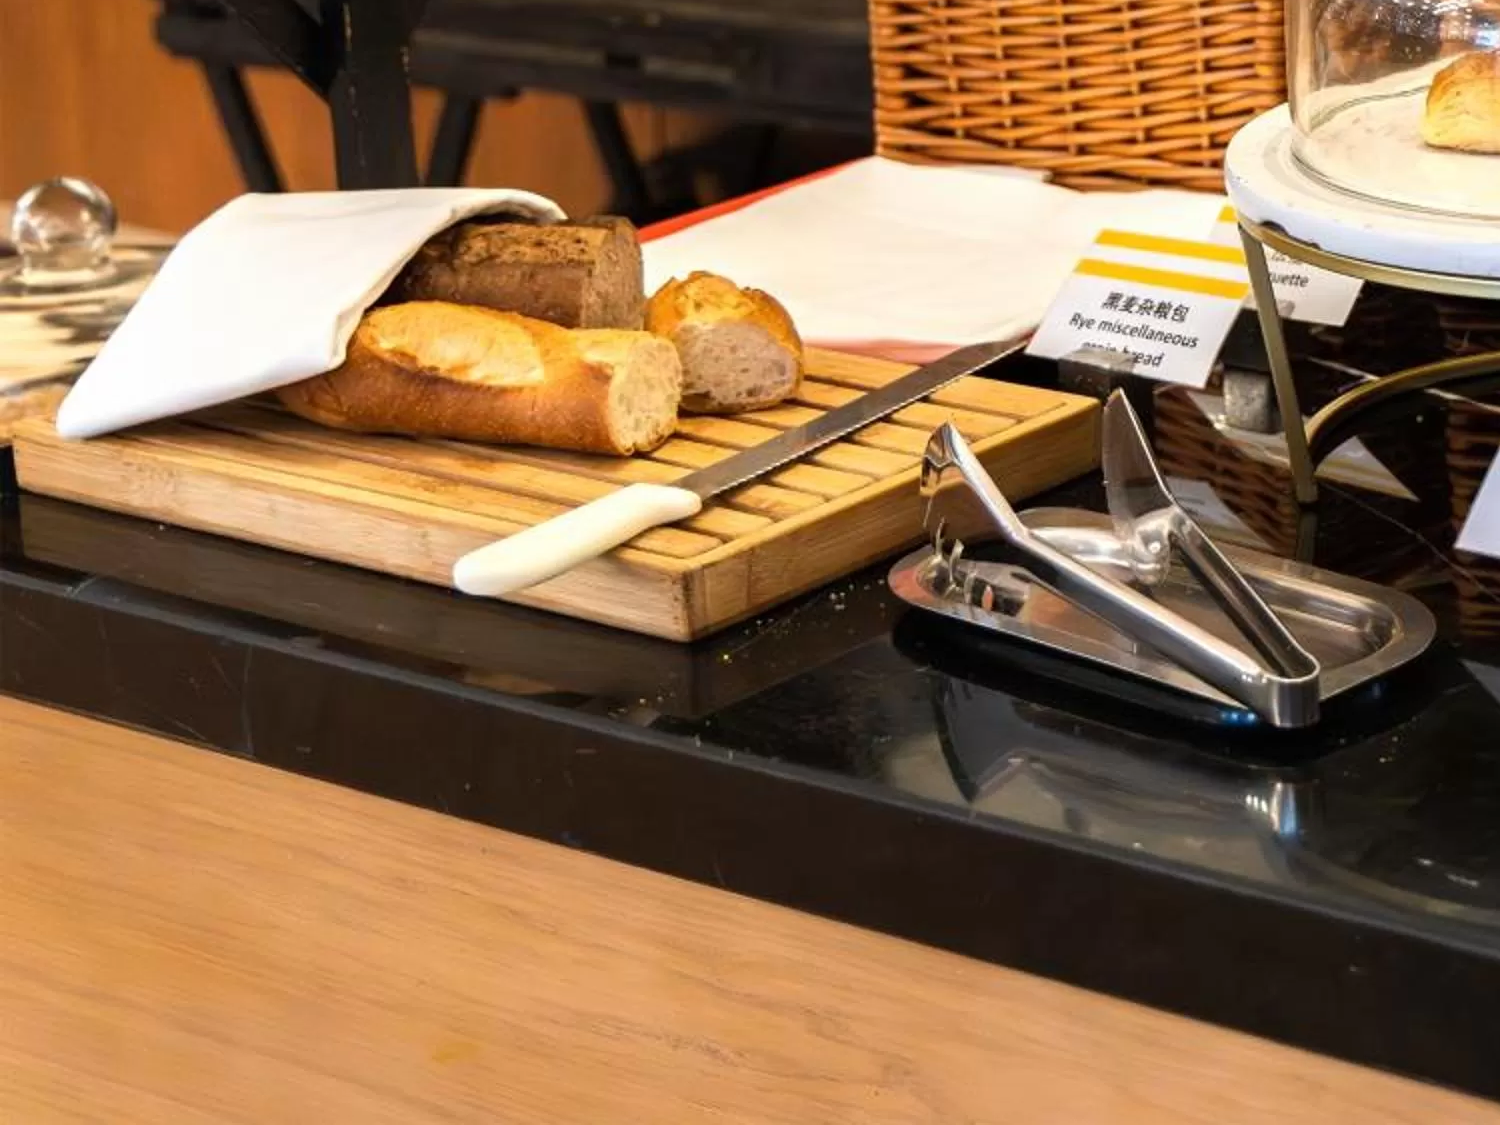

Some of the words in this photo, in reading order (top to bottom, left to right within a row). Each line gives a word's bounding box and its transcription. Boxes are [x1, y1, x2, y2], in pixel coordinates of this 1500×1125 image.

[1101, 291, 1191, 323] 黑麦杂粮包
[1069, 312, 1096, 331] Rye
[1097, 318, 1200, 349] miscellaneous
